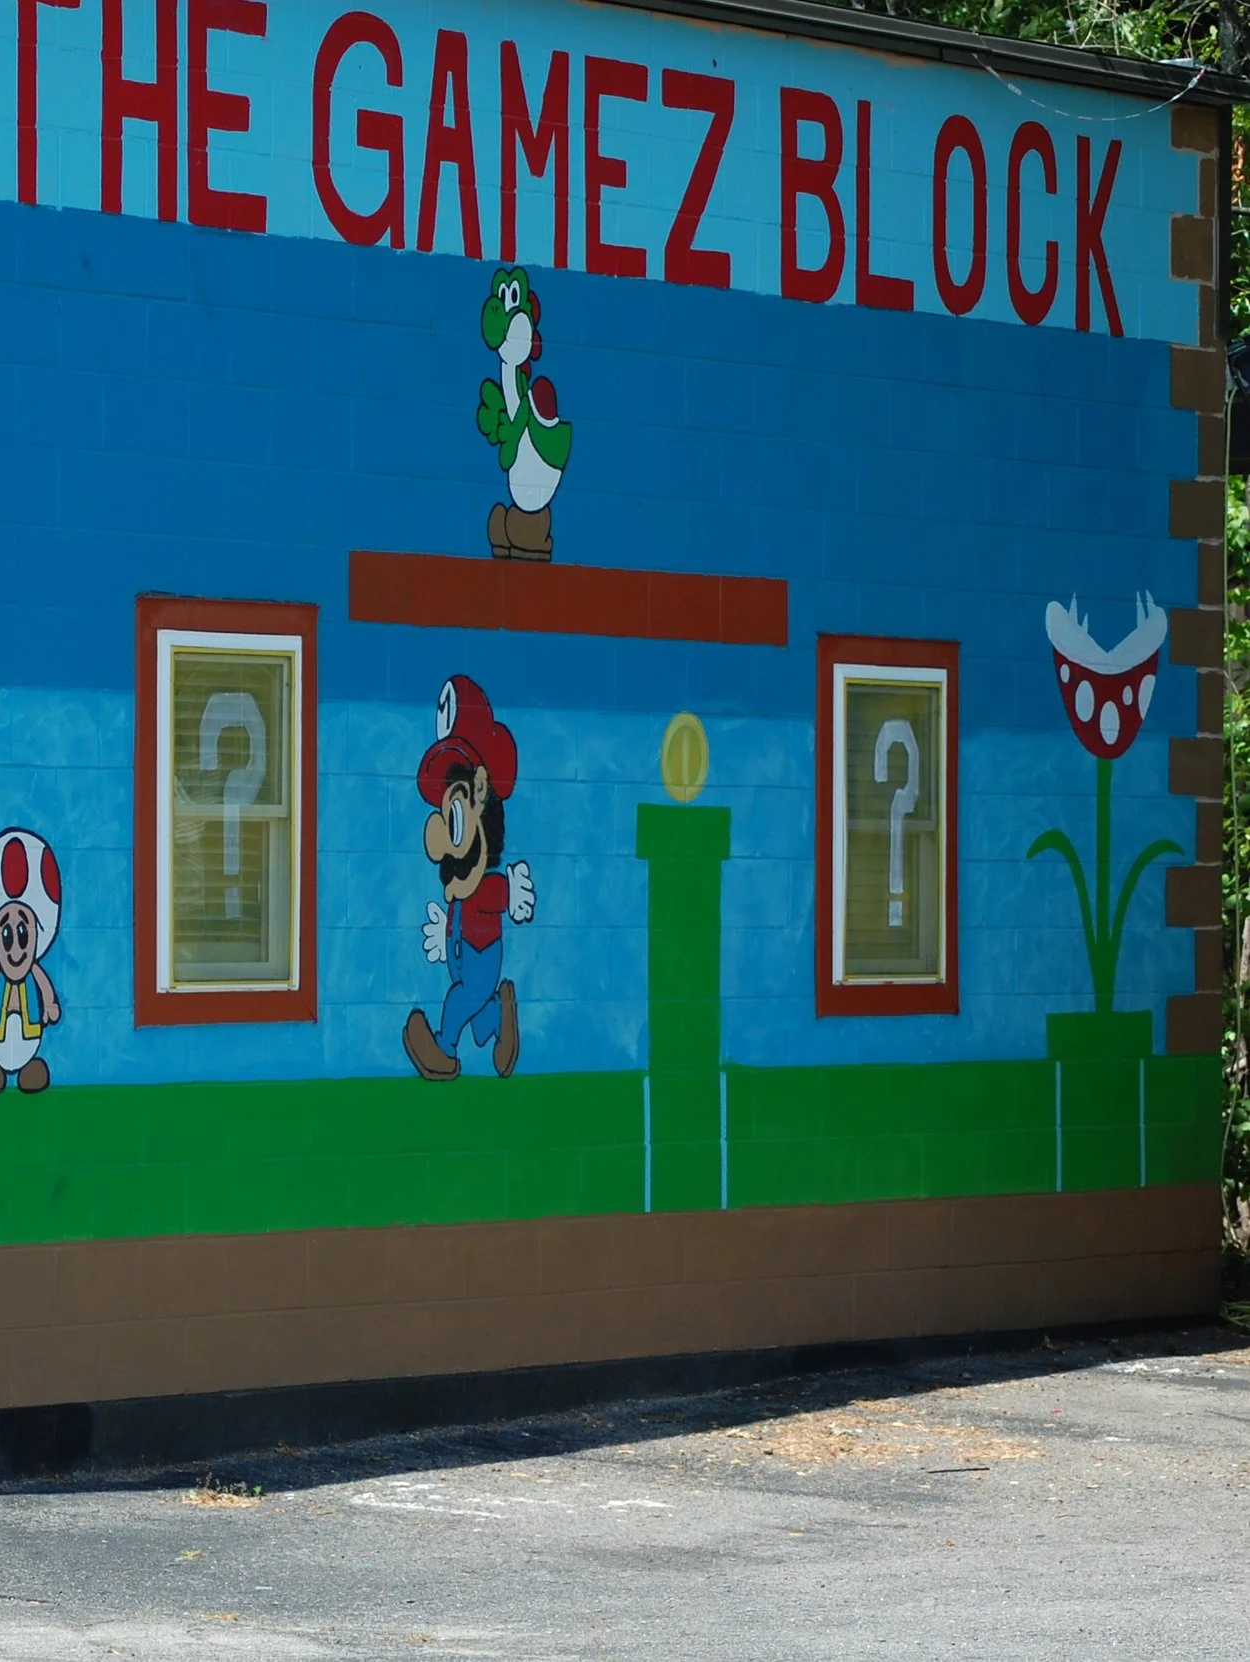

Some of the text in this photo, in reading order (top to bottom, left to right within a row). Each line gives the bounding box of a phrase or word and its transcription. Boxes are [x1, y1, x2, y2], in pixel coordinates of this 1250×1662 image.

[17, 0, 1125, 337] THE GAMEZ BLOCK
